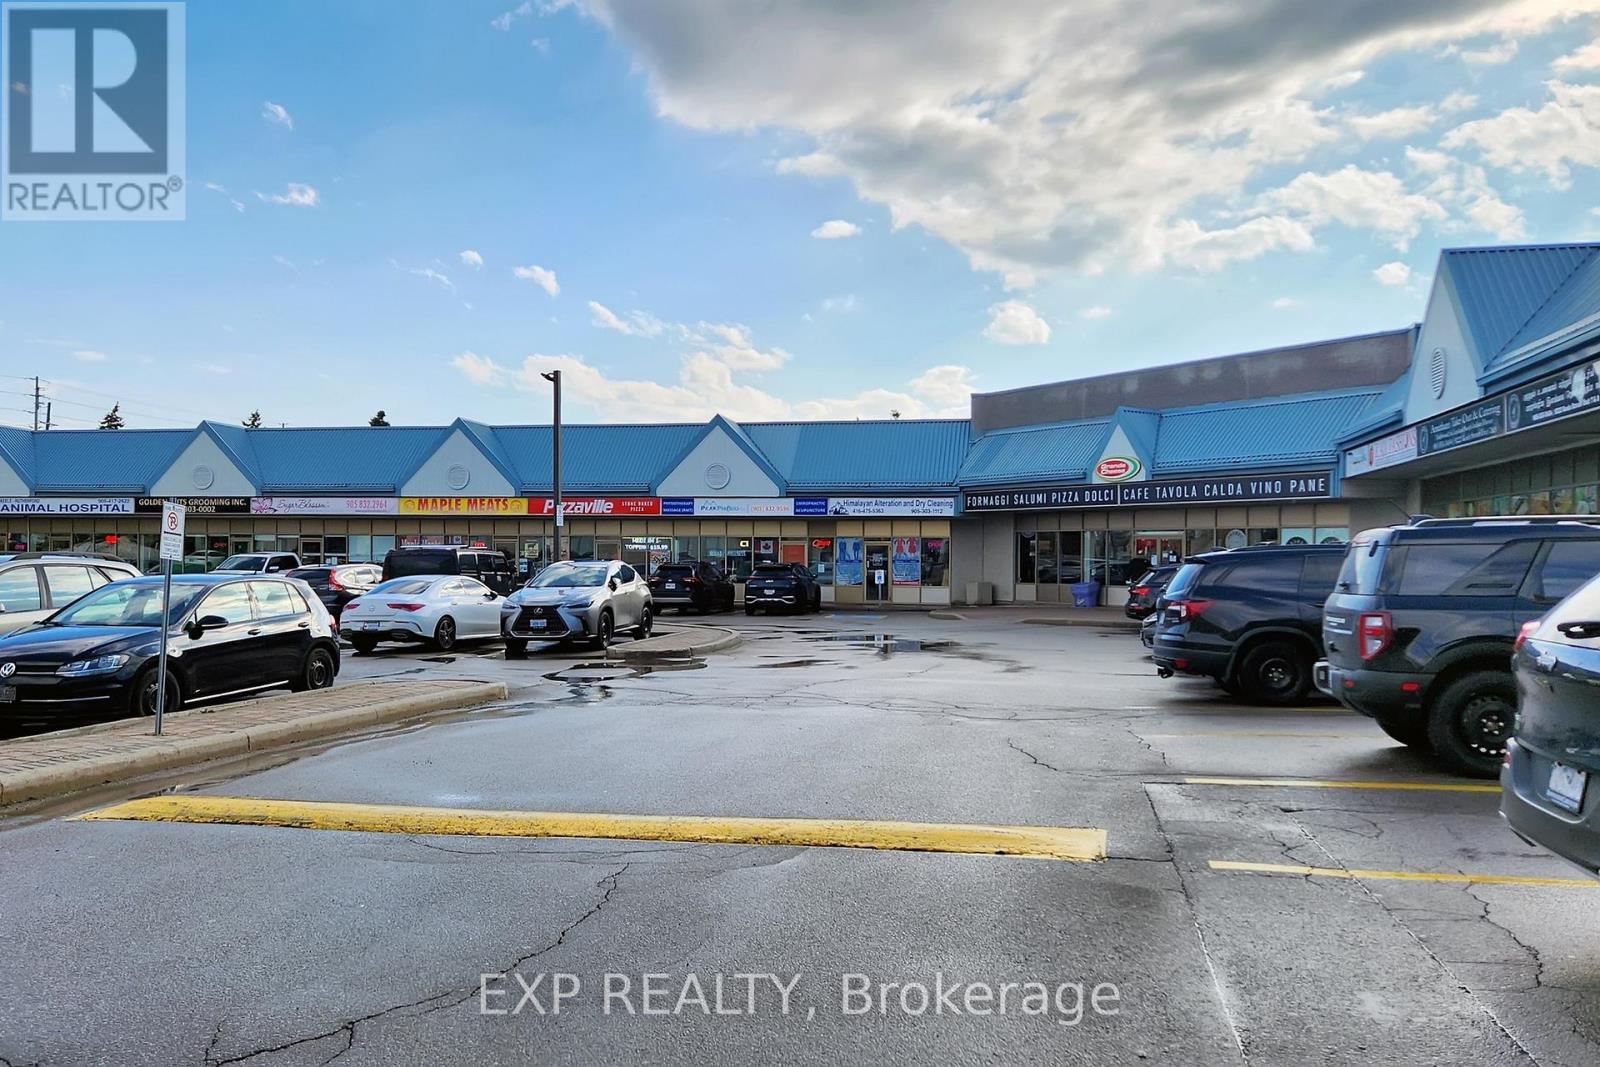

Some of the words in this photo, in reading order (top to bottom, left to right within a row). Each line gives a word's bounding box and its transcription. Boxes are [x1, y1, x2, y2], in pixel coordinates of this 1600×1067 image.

[967, 495, 1010, 507] FORMAGGI
[1014, 493, 1047, 505] SALUMI
[1051, 491, 1079, 503] PIZZA
[1084, 489, 1114, 502] DOLCI
[1123, 487, 1150, 500] CAFE
[1155, 485, 1197, 498] TAVOLA
[1204, 483, 1243, 497] CALDA
[1250, 480, 1282, 494] VINO
[1289, 478, 1325, 493] PANE
[1, 503, 55, 512] ANIMAL
[60, 503, 129, 512] HOSPITAL
[417, 498, 462, 511] MAPLE
[466, 498, 509, 511] MEATS
[543, 499, 614, 513] Pzzaville
[843, 499, 874, 508] Himalayan
[874, 499, 902, 507] Alteration
[903, 499, 914, 507] and
[915, 499, 926, 508] Dry
[927, 499, 953, 508] Cleaning
